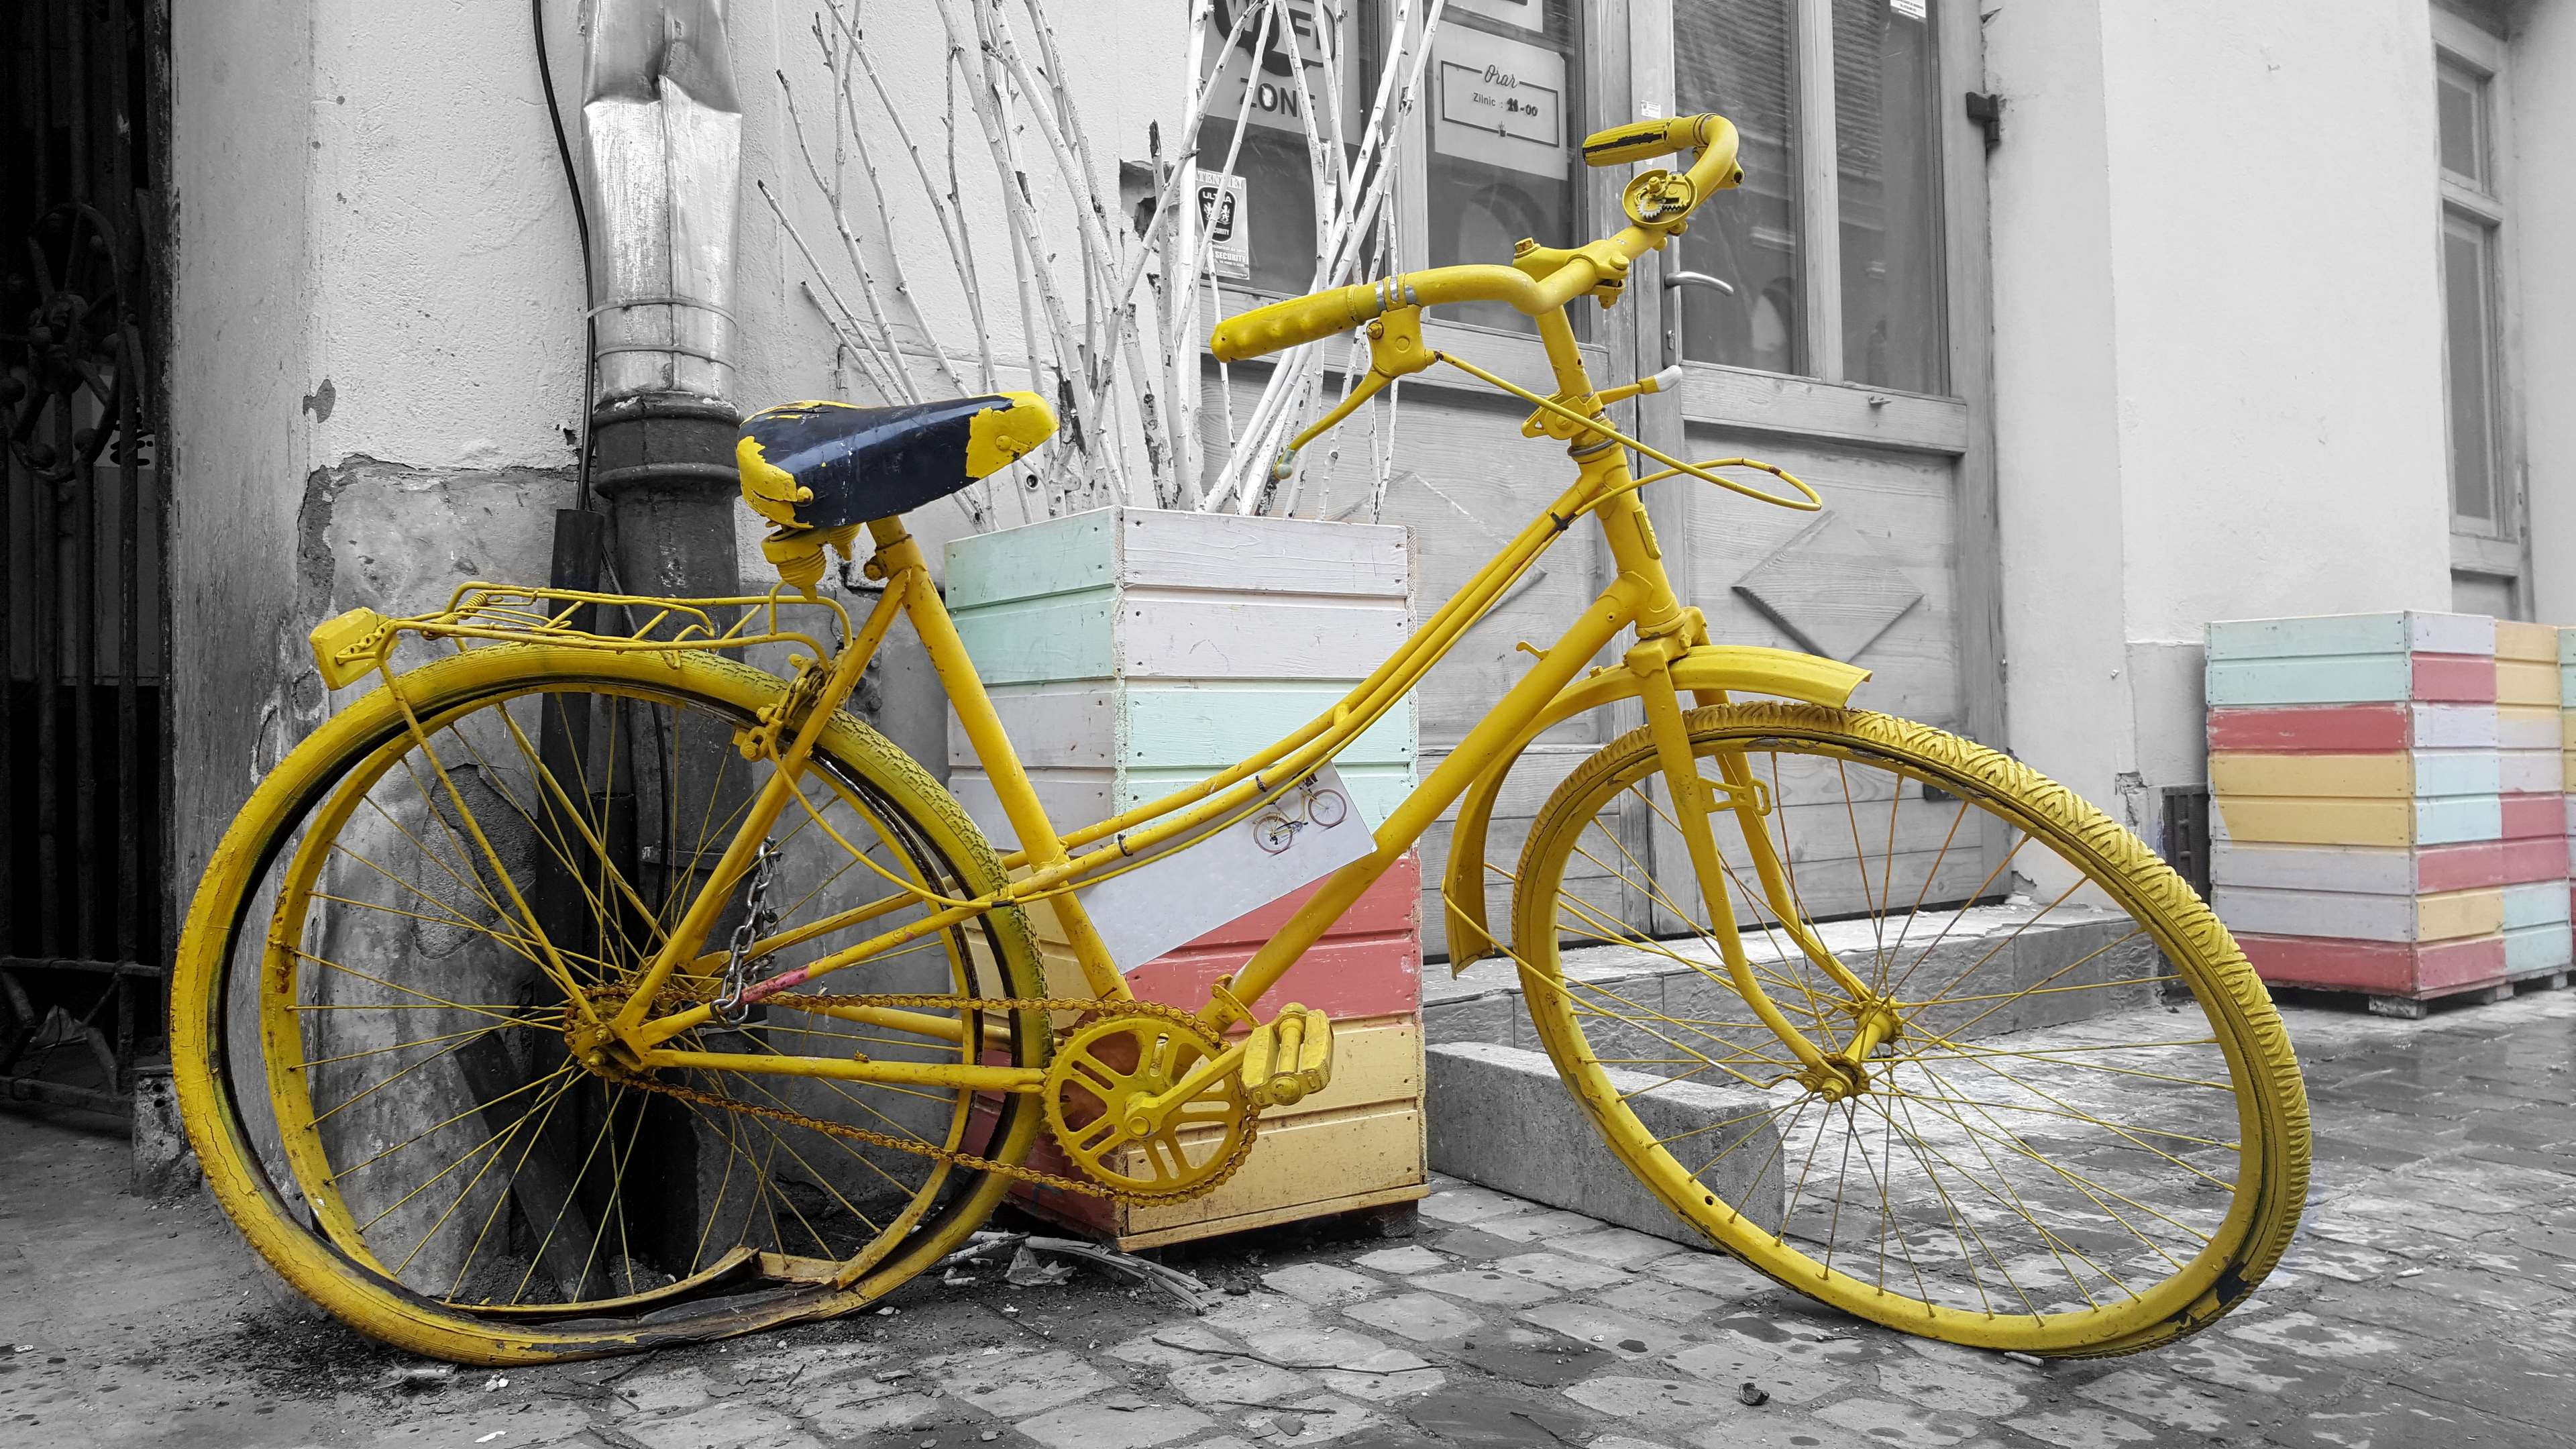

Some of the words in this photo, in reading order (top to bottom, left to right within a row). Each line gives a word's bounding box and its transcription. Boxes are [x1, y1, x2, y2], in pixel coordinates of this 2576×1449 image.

[1485, 64, 1517, 89] Orar
[1473, 92, 1496, 107] Zilnic
[1202, 191, 1232, 203] ULA
[1215, 251, 1246, 262] SECURITY
